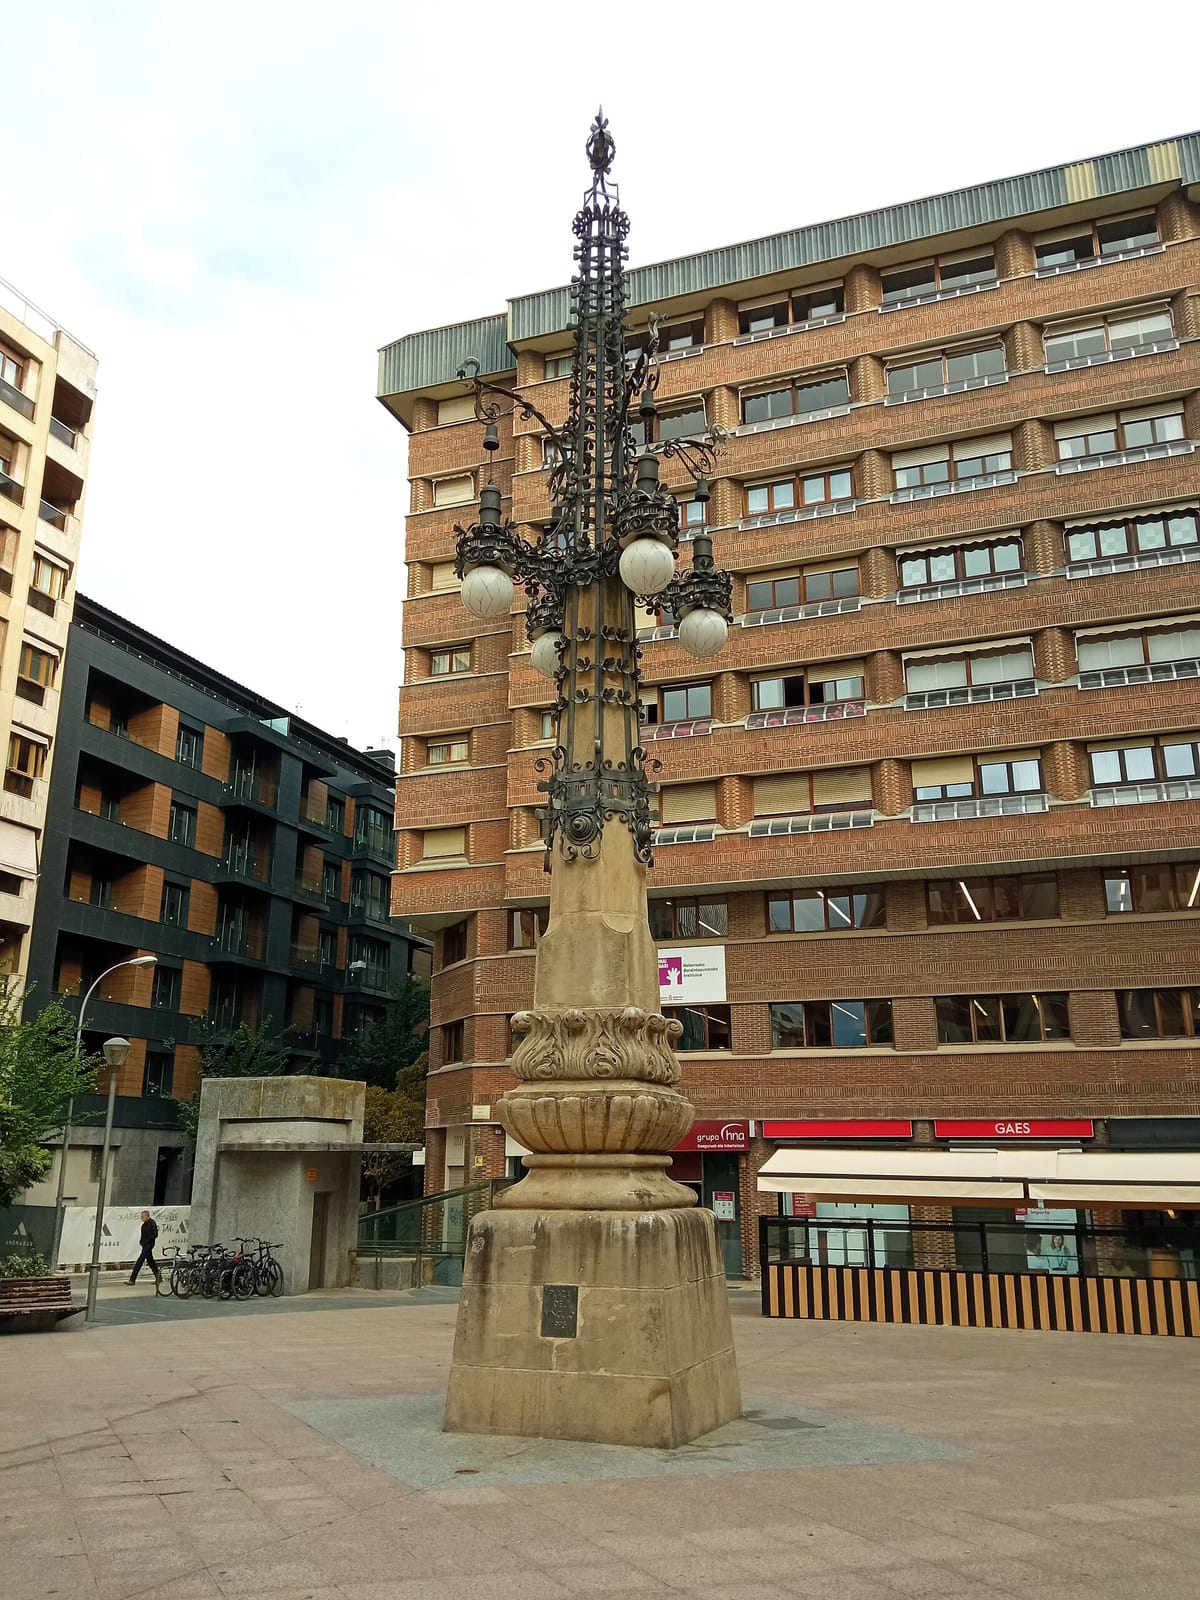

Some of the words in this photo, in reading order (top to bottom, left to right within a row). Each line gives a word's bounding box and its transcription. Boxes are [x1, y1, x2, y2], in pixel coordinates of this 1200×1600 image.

[995, 1122, 1030, 1134] GAES
[697, 1134, 719, 1142] grupo
[726, 1129, 744, 1141] hna
